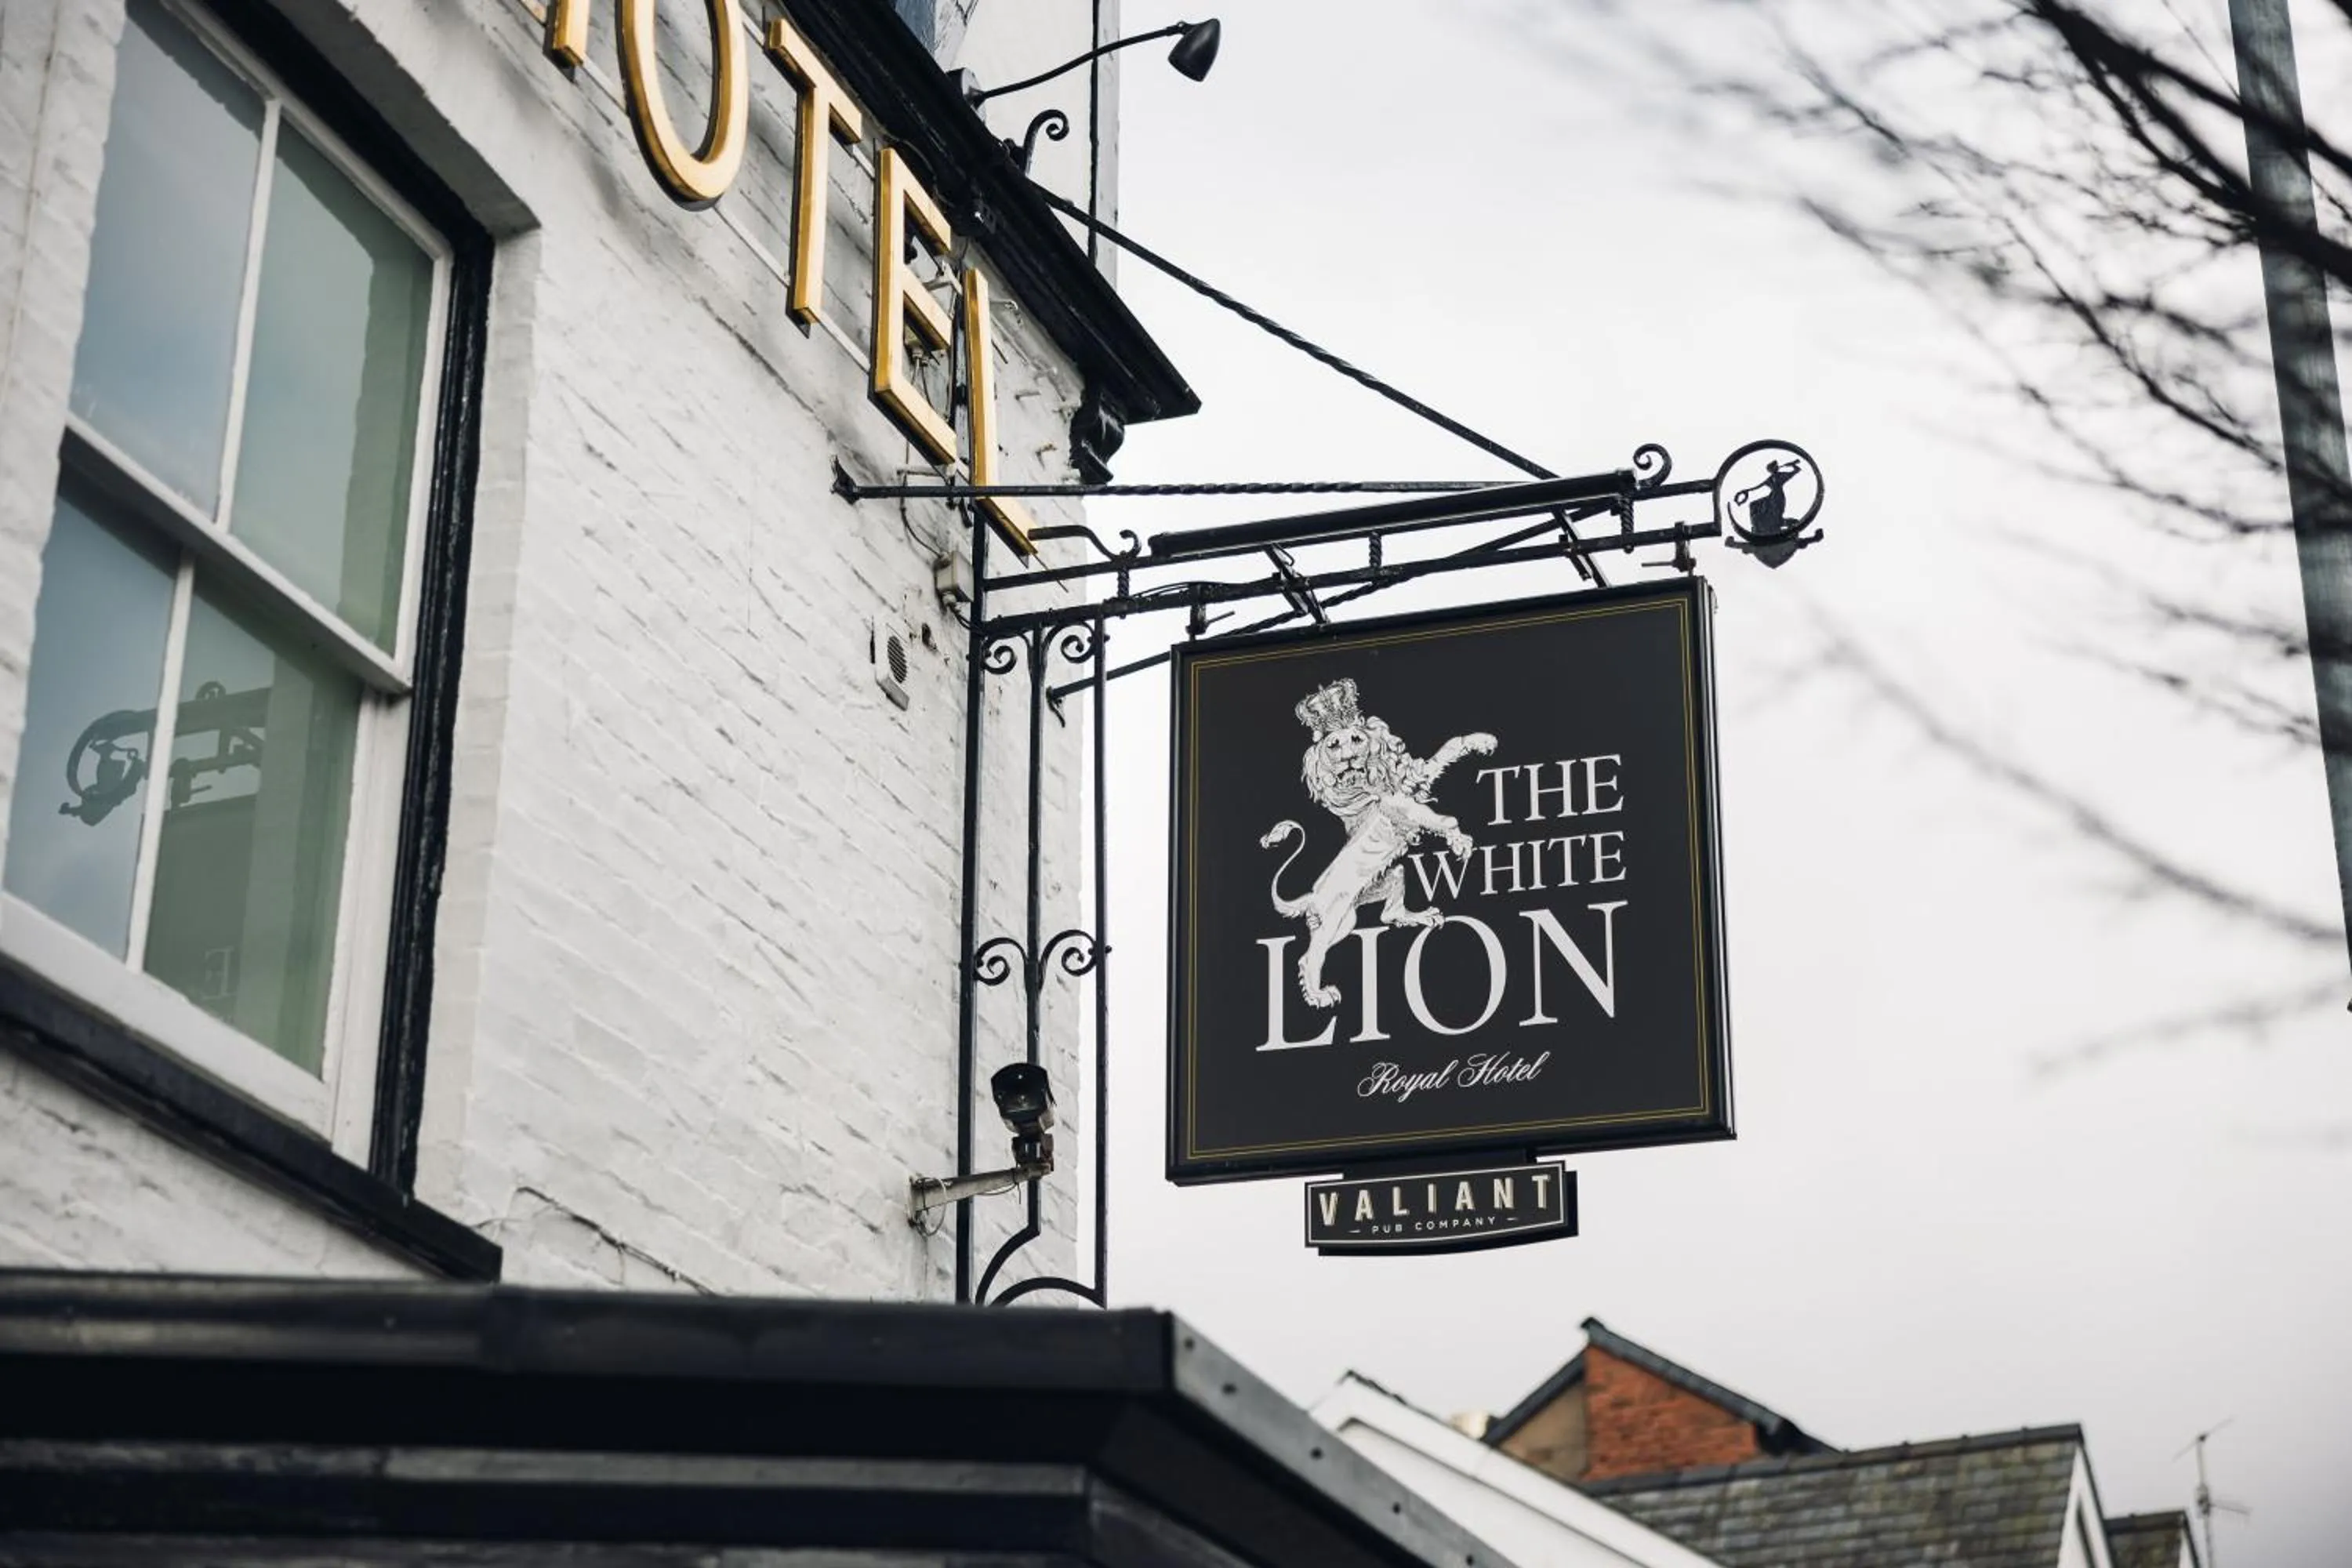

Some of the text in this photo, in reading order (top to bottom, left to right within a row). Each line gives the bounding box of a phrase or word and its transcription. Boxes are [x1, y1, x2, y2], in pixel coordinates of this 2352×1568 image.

[549, 0, 1038, 557] OTEL
[1476, 753, 1624, 826] THE
[1408, 830, 1628, 902] WHITE
[1255, 900, 1628, 1051] LION
[1357, 1051, 1551, 1102] Royal Hotel
[1319, 1174, 1552, 1226] VALIANT
[1372, 1216, 1497, 1234] PUB COMPANY
